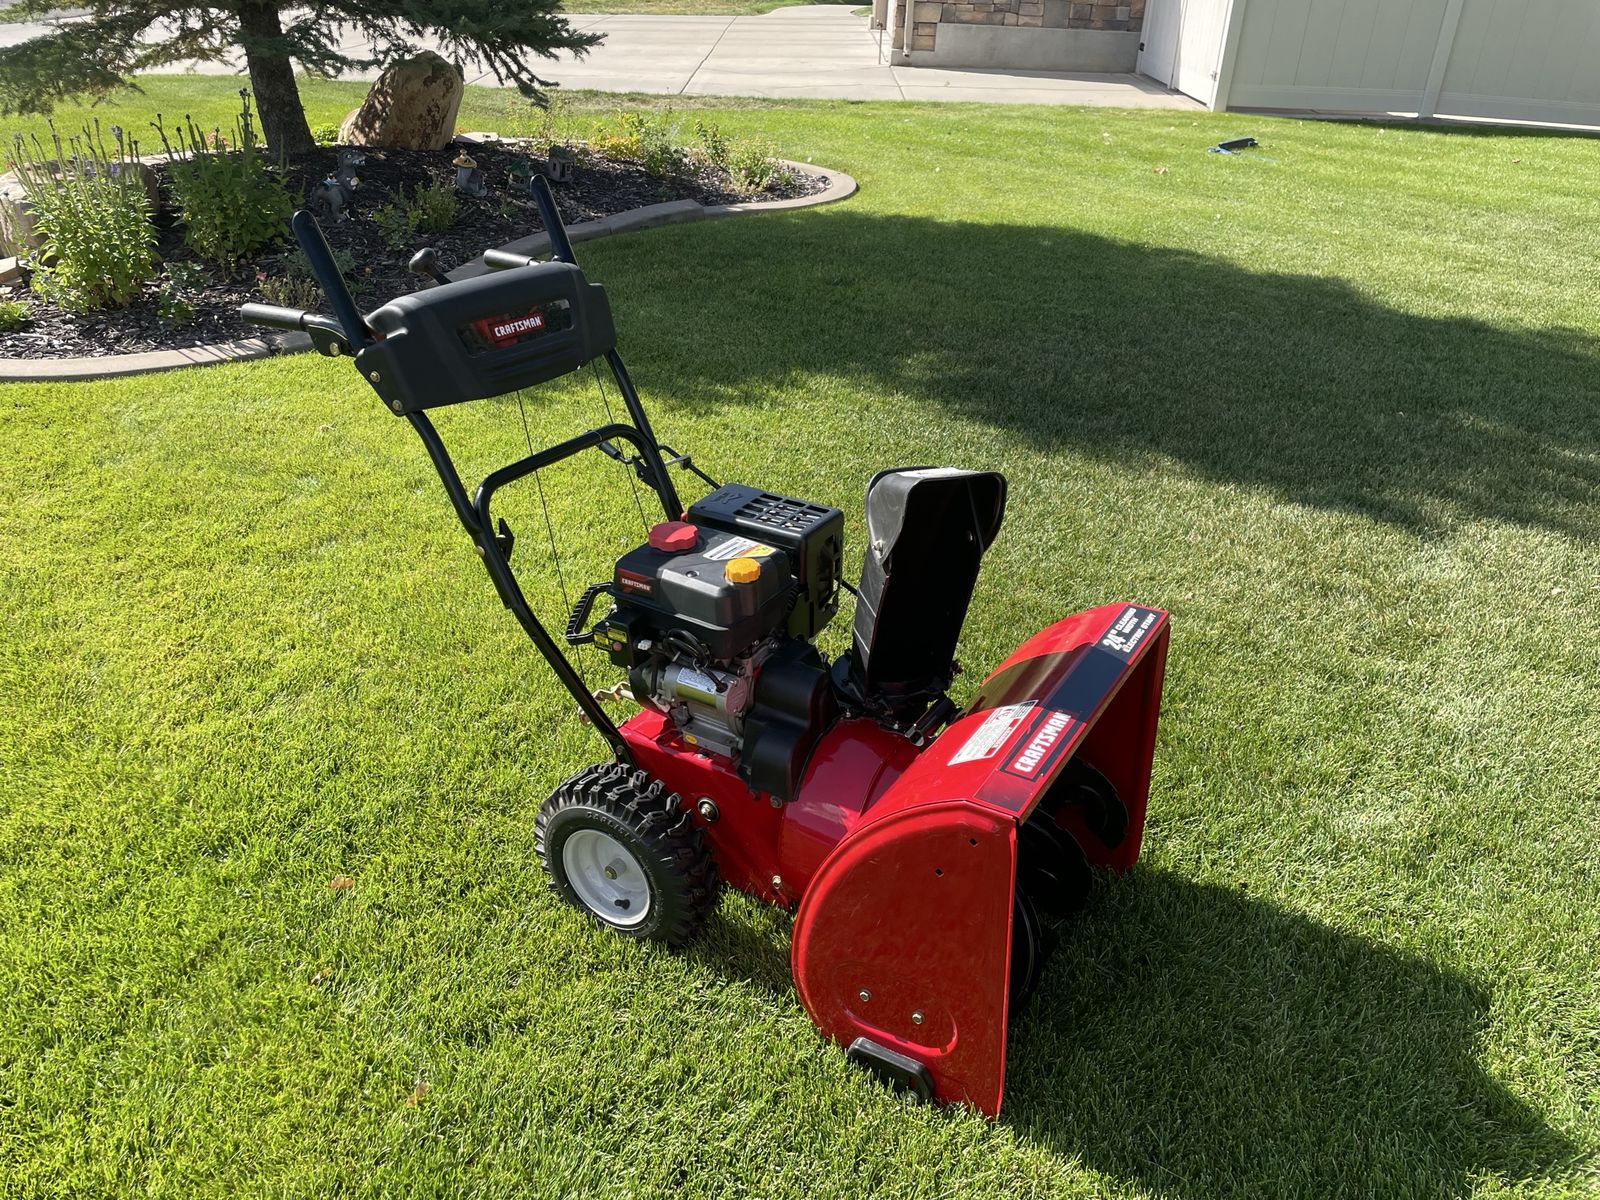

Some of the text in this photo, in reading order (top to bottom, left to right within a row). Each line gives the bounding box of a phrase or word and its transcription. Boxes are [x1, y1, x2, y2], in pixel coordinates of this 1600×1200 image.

[494, 316, 542, 337] CRAFTSMAN
[621, 577, 651, 592] CRAFTSMAN
[1102, 628, 1127, 651] 24"
[1122, 612, 1157, 653] ELECTRIC START
[1013, 711, 1072, 773] CRAFTSMAN
